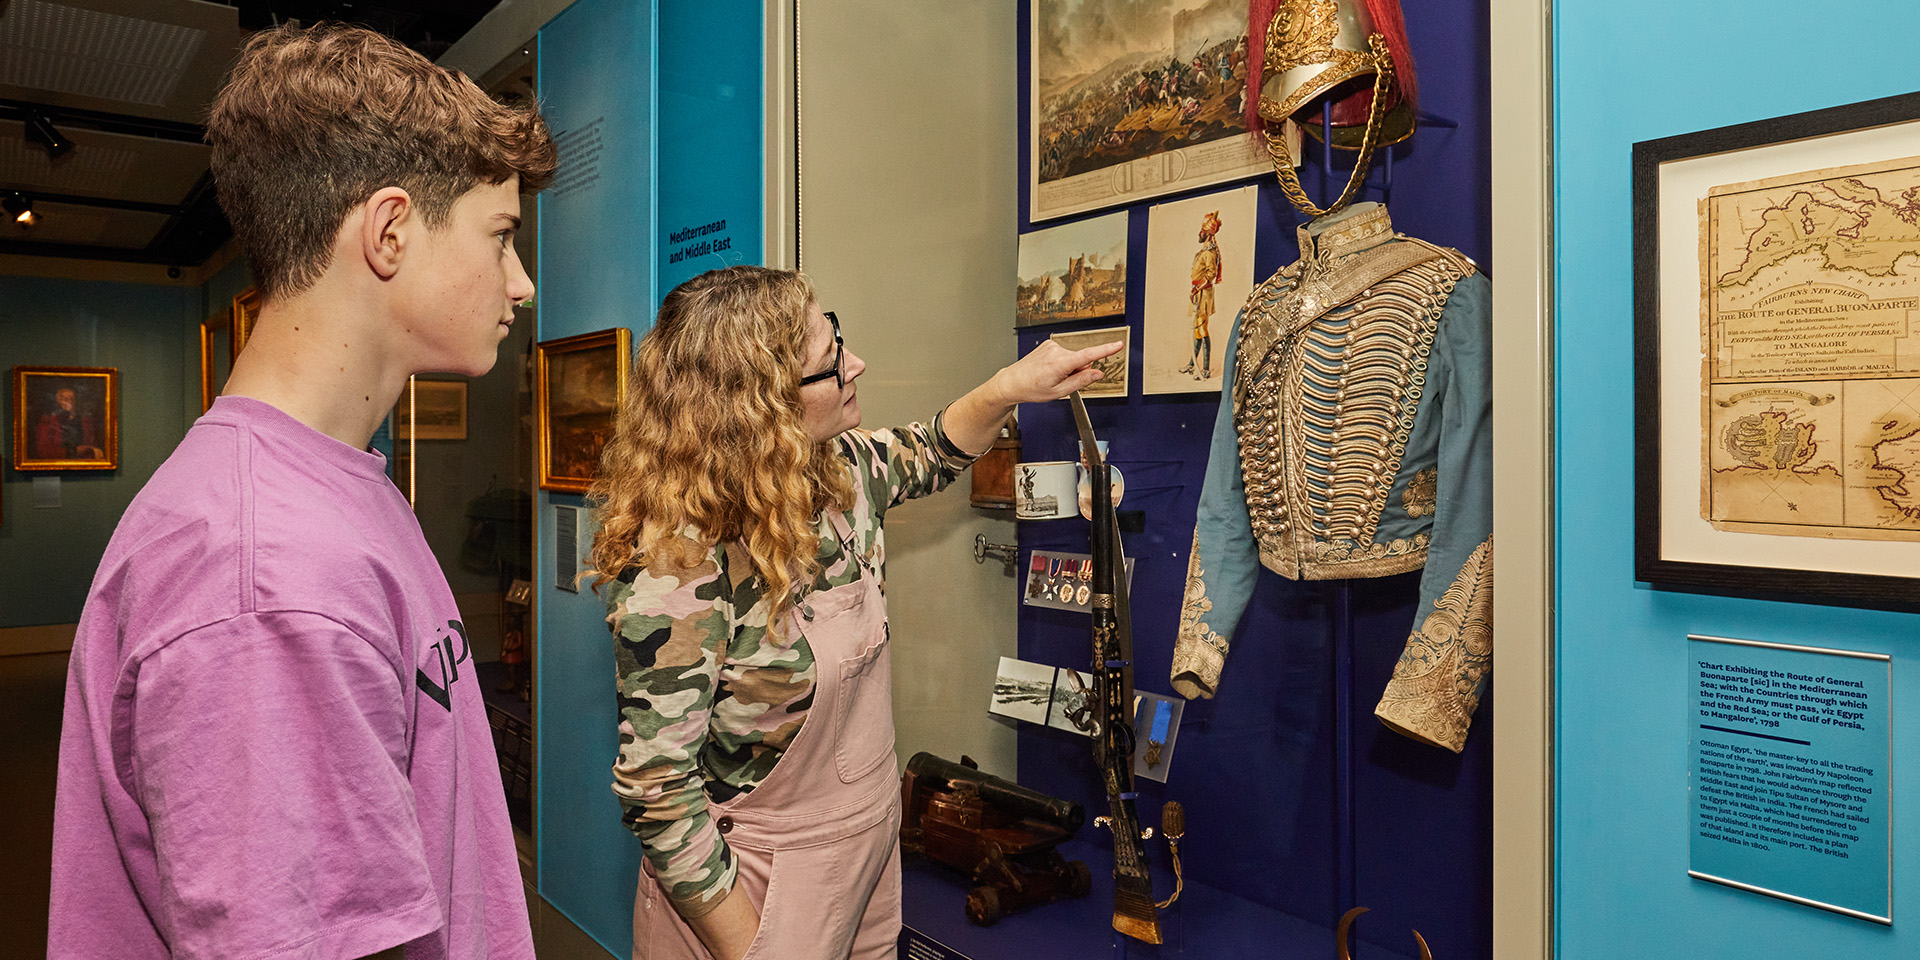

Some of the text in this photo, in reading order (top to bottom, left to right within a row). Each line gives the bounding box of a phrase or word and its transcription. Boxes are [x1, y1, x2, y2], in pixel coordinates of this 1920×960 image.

[670, 219, 726, 245] Mediterranean
[670, 236, 731, 264] and Middle East
[1810, 287, 1833, 295] NEW
[1833, 288, 1864, 299] CHART
[1737, 309, 1774, 319] ROUTE
[1786, 304, 1836, 316] GENERAL
[1836, 300, 1917, 312] BUONAPARTE
[1789, 341, 1848, 350] MANGALORE
[1700, 671, 1867, 699] Buonaparte [sic] in the Mediterranean
[1726, 665, 1768, 678] Exhibiting
[1770, 670, 1785, 678] the
[1787, 673, 1813, 682] Route
[1827, 678, 1863, 688] General
[1700, 681, 1867, 709] Sea; with the Countries through which
[1700, 690, 1864, 720] the French Army must pass, viz Egypt
[1717, 702, 1731, 710] the
[1733, 705, 1749, 713] Red
[1751, 707, 1769, 717] Sea;
[1783, 712, 1798, 720] the
[1800, 715, 1820, 723] Gulf
[1833, 719, 1865, 731] Persia,
[1760, 719, 1779, 727] 1798
[1700, 740, 1729, 749] Ottoman
[1731, 745, 1752, 754] Egypt,
[1769, 753, 1809, 765] master-key
[1845, 765, 1873, 776] trading
[1700, 750, 1725, 758] nations
[1786, 763, 1814, 774] invaded
[1816, 769, 1825, 777] by
[1827, 771, 1864, 783] Napoleon
[1700, 758, 1734, 769] Bonaparte
[1819, 780, 1836, 789] map
[1838, 784, 1872, 794] reflected
[1700, 767, 1721, 776] British
[1723, 771, 1740, 779] fears
[1767, 780, 1789, 788] would
[1790, 785, 1821, 794] advance
[1822, 790, 1852, 801] through
[1854, 795, 1867, 803] the
[1700, 776, 1723, 785] Middle
[1724, 781, 1738, 789] East
[1754, 786, 1767, 794] join
[1769, 789, 1784, 797] Tipu
[1786, 792, 1809, 802] Sultan
[1820, 799, 1846, 809] Mysore
[1700, 785, 1721, 794] defeat
[1736, 792, 1758, 801] British
[1767, 799, 1787, 807] India.
[1789, 802, 1802, 810] The
[1804, 806, 1829, 815] French
[1830, 810, 1845, 818] had
[1847, 815, 1869, 823] sailed
[1700, 804, 1718, 812] them
[1719, 807, 1731, 815] just
[1739, 812, 1762, 821] couple
[1772, 819, 1799, 829] months
[1801, 823, 1824, 834] before
[1826, 829, 1840, 837] this
[1842, 834, 1859, 842] map
[1709, 796, 1728, 805] Egypt
[1740, 802, 1762, 812] Malta,
[1763, 808, 1785, 816] which
[1786, 811, 1800, 819] had
[1801, 816, 1847, 829] surrendered
[1700, 832, 1721, 840] seized
[1722, 836, 1741, 845] Malta
[1751, 842, 1770, 851] 1800.
[1708, 823, 1722, 831] that
[1724, 826, 1744, 836] island
[1789, 842, 1807, 850] port.
[1809, 845, 1823, 853] The
[1824, 848, 1848, 858] British
[1715, 817, 1750, 828] published.
[1759, 825, 1791, 837] therefore
[1793, 831, 1823, 843] includes
[1831, 841, 1848, 849] plan
